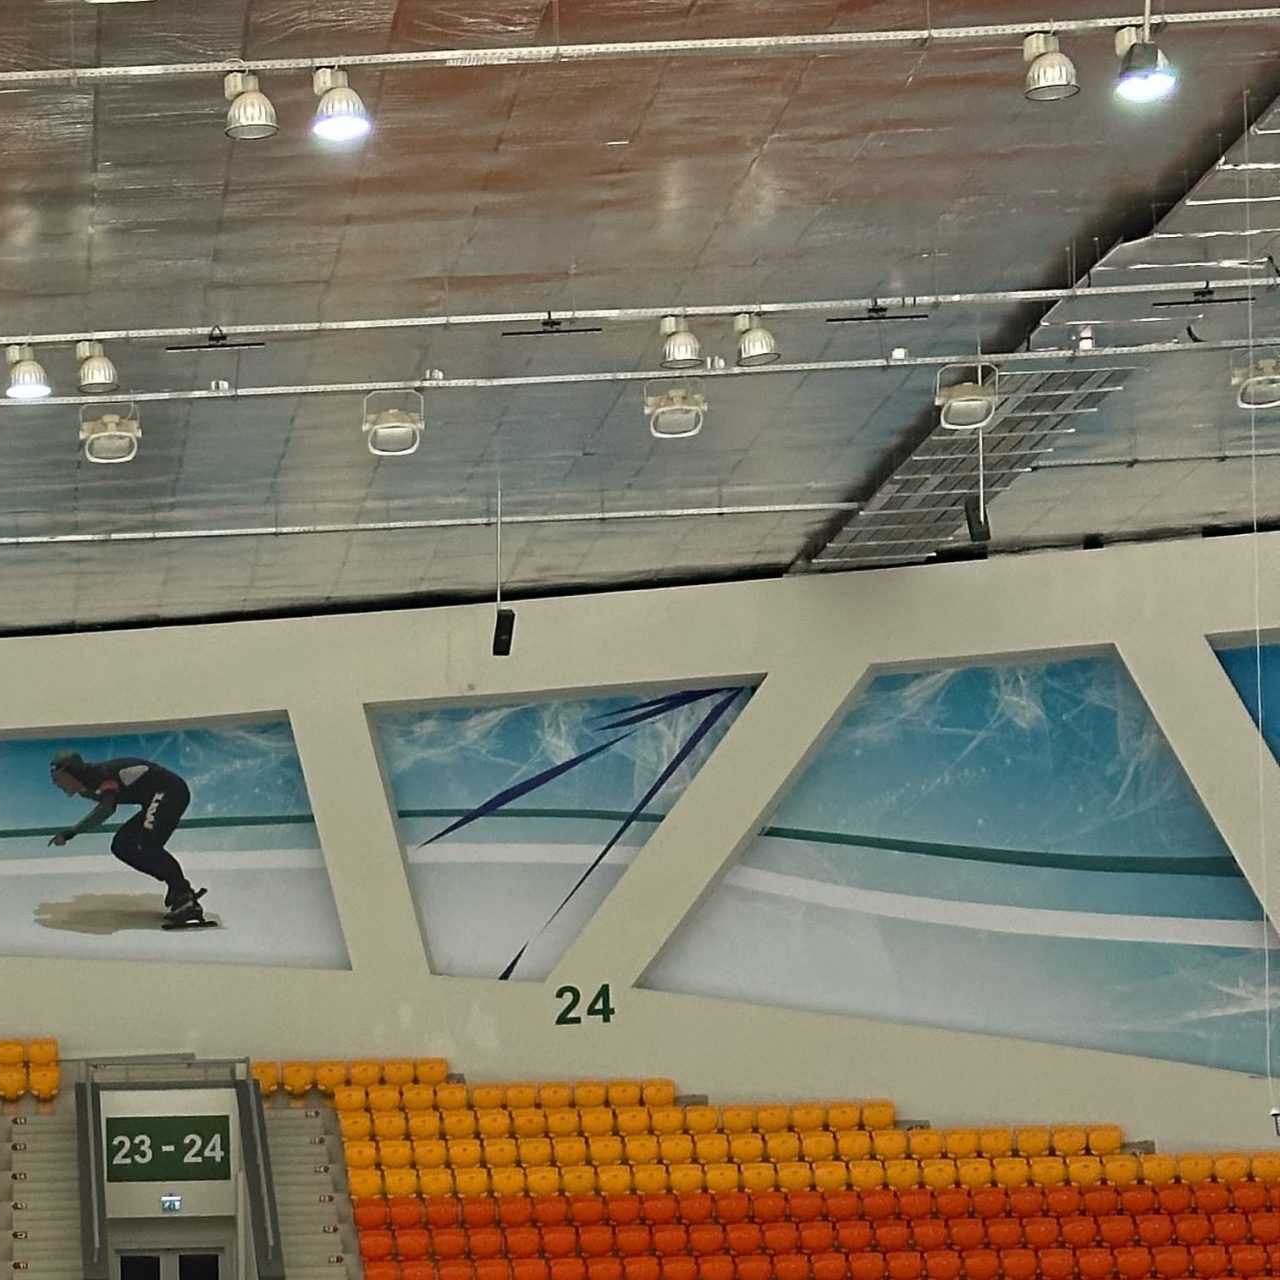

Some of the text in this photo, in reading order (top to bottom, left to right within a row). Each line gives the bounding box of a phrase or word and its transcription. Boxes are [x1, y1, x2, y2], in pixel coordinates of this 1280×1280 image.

[555, 983, 616, 1025] 24
[112, 1134, 153, 1165] 23
[183, 1133, 225, 1163] 24
